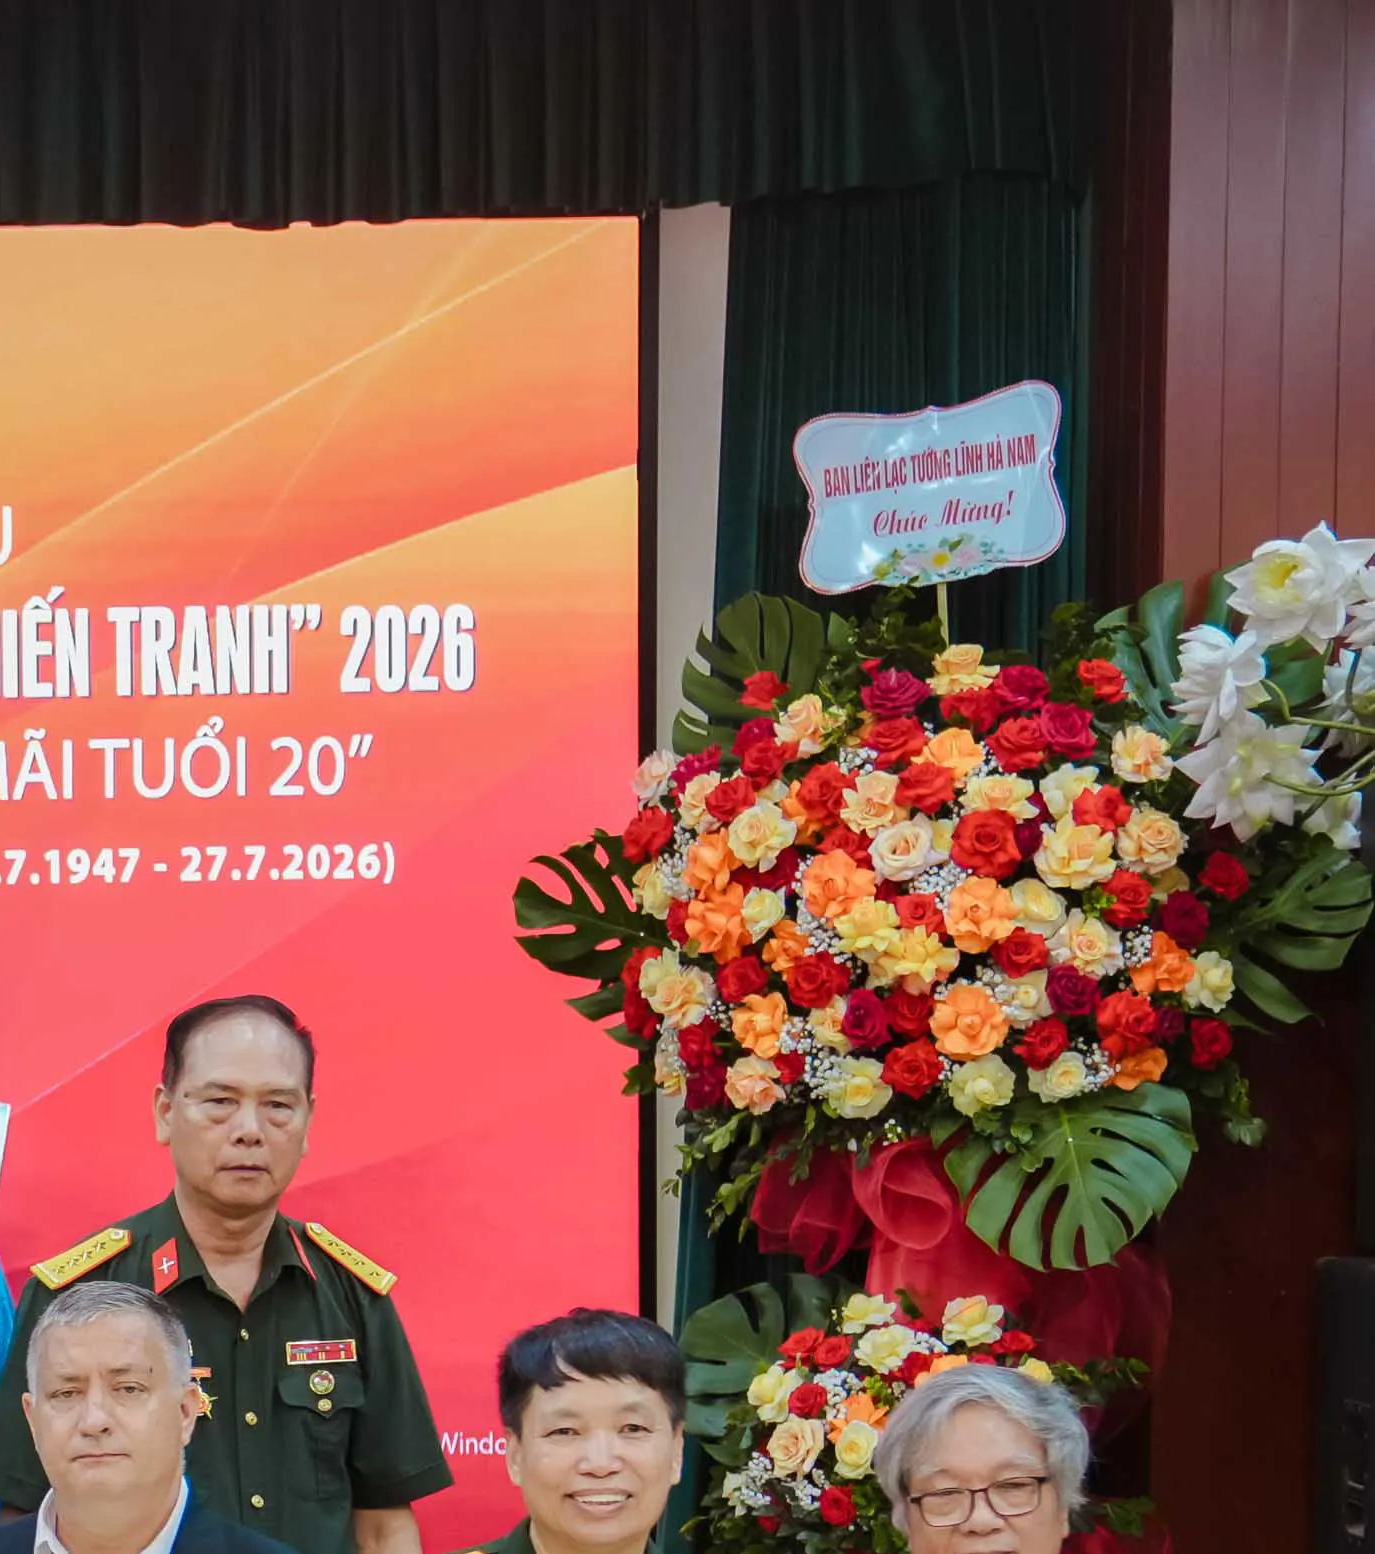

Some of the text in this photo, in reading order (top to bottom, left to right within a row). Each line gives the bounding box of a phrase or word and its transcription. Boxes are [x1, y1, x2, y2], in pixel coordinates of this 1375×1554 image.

[824, 433, 1036, 498] BAN LIÊN LẠC TƯỚNG LĨNH HÀ NAM
[873, 490, 1014, 537] Chúc Mừng!
[107, 603, 321, 697] TRANH”
[340, 603, 475, 693] 2026
[88, 715, 246, 799] TUỔI
[269, 733, 373, 796] 20”
[153, 863, 168, 872] -
[180, 841, 395, 884] 27.7.2026)
[440, 1431, 508, 1456] Windo
